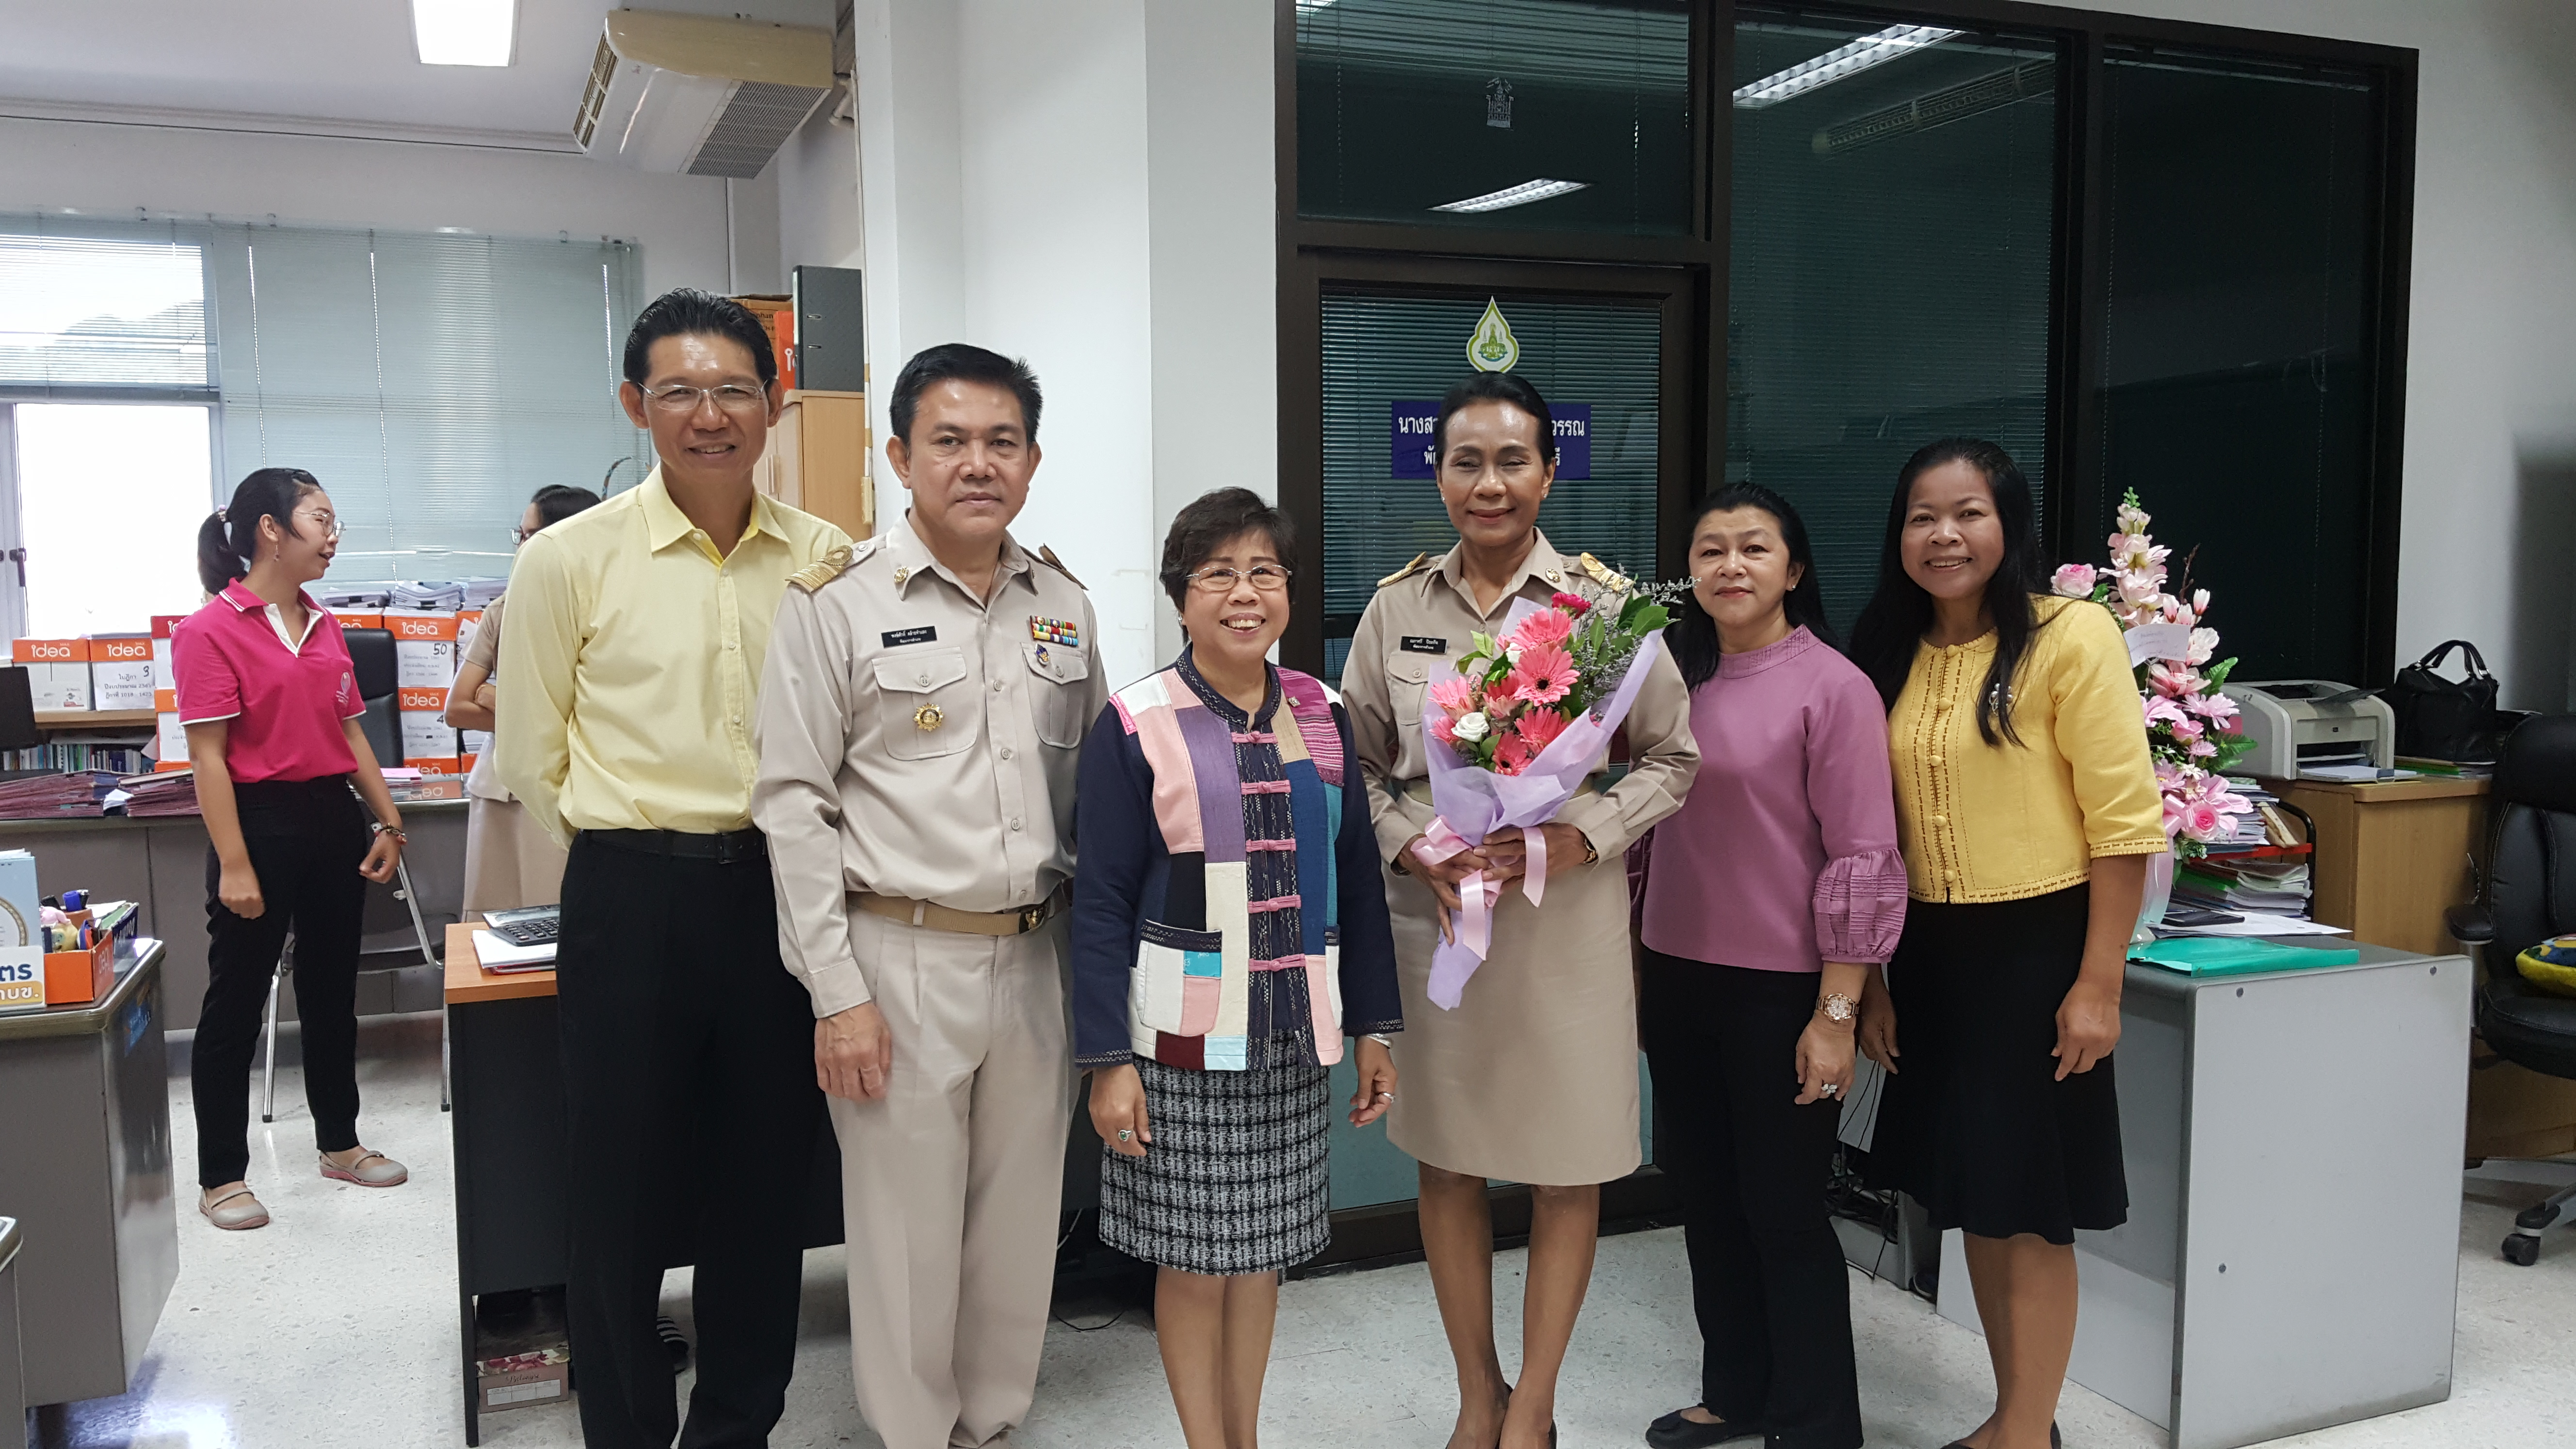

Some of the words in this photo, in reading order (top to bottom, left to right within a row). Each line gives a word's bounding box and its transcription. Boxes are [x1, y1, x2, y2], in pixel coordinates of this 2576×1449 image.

[1399, 417, 1438, 434] นางส
[402, 621, 438, 635] idea
[32, 643, 70, 658] idea
[107, 643, 146, 657] idea
[433, 643, 447, 655] 50
[403, 692, 439, 707] idea
